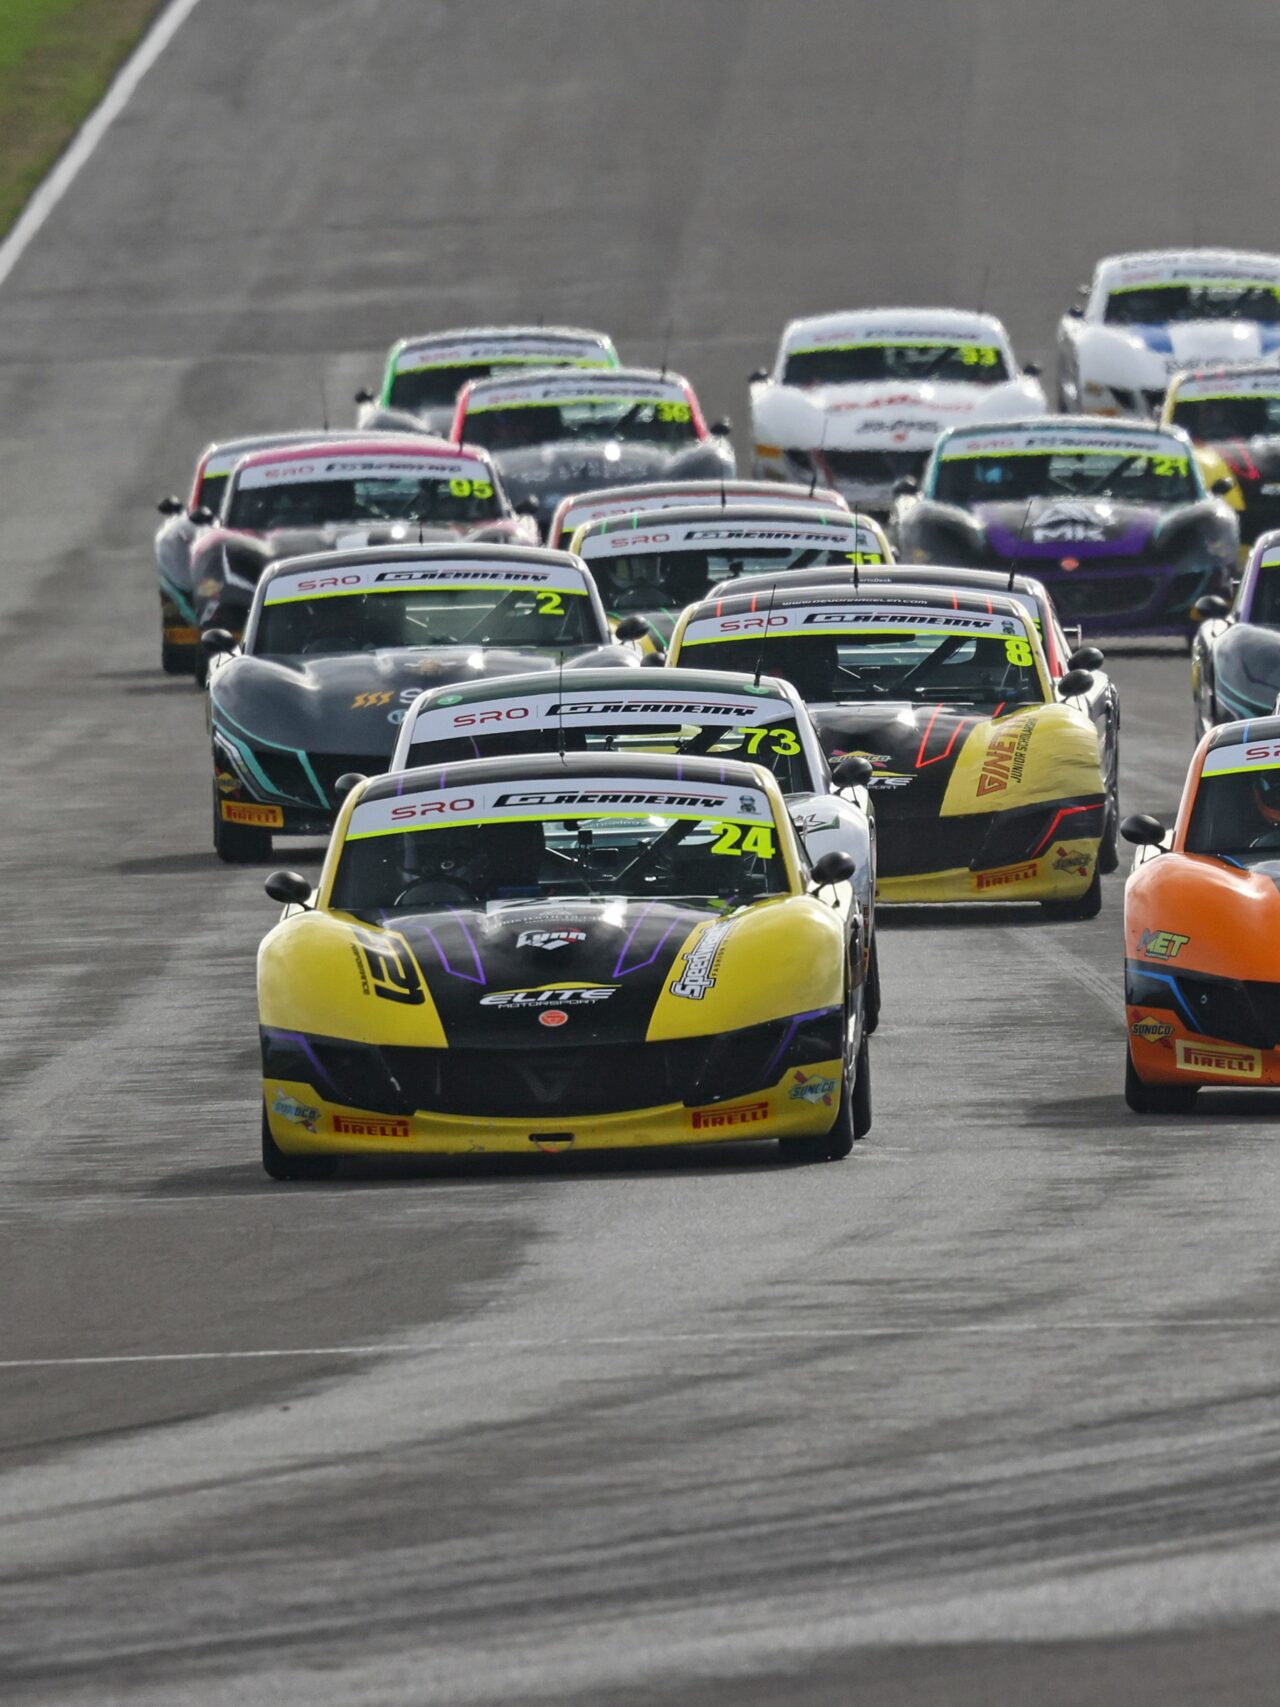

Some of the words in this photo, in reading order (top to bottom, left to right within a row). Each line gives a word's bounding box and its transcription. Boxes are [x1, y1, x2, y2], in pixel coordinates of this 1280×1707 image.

[449, 479, 494, 500] 95
[611, 533, 670, 549] SRO
[297, 575, 361, 592] SRO
[535, 591, 566, 616] 2
[720, 615, 789, 633] SRO
[1004, 638, 1034, 667] 8
[453, 706, 529, 728] SRO
[736, 726, 801, 757] 73
[1010, 751, 1027, 784] JUNIOR
[392, 797, 475, 821] SRO
[710, 822, 776, 860] 24
[479, 988, 617, 1006] ELITE
[497, 1000, 599, 1009] MOTORSPORT
[1131, 1023, 1174, 1037] SUNOCO
[1183, 1046, 1256, 1073] PIRELLI
[332, 1114, 410, 1138] PIRELLI
[691, 1101, 769, 1130] PIRELLI
